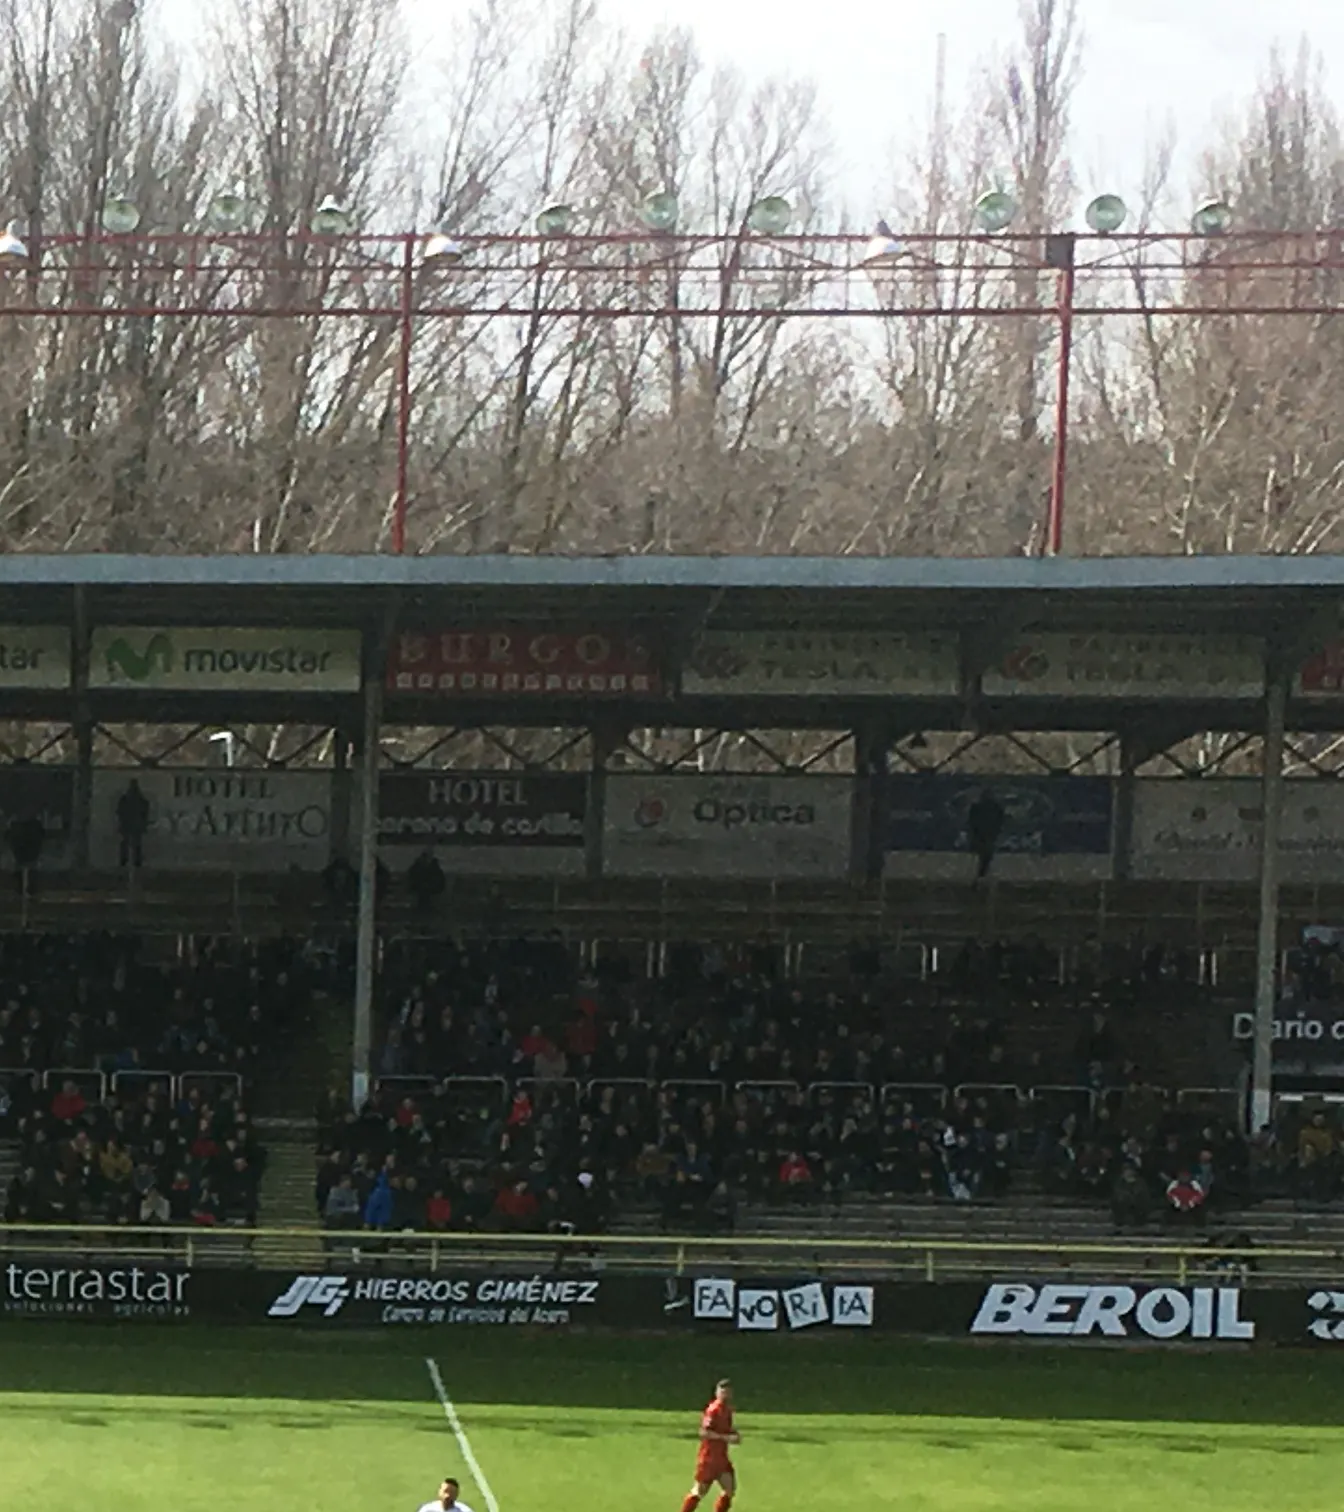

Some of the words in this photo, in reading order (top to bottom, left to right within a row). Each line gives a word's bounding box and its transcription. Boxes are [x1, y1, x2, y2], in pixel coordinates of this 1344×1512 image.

[182, 643, 331, 674] movistar
[398, 631, 652, 666] BURGOS
[428, 778, 529, 806] HOTEL
[1232, 1011, 1324, 1041] Dario
[5, 1262, 192, 1303] terrastar
[354, 1278, 470, 1302] HIERROS
[475, 1272, 600, 1304] GIMÉNEZ
[970, 1284, 1256, 1339] BEROIL
